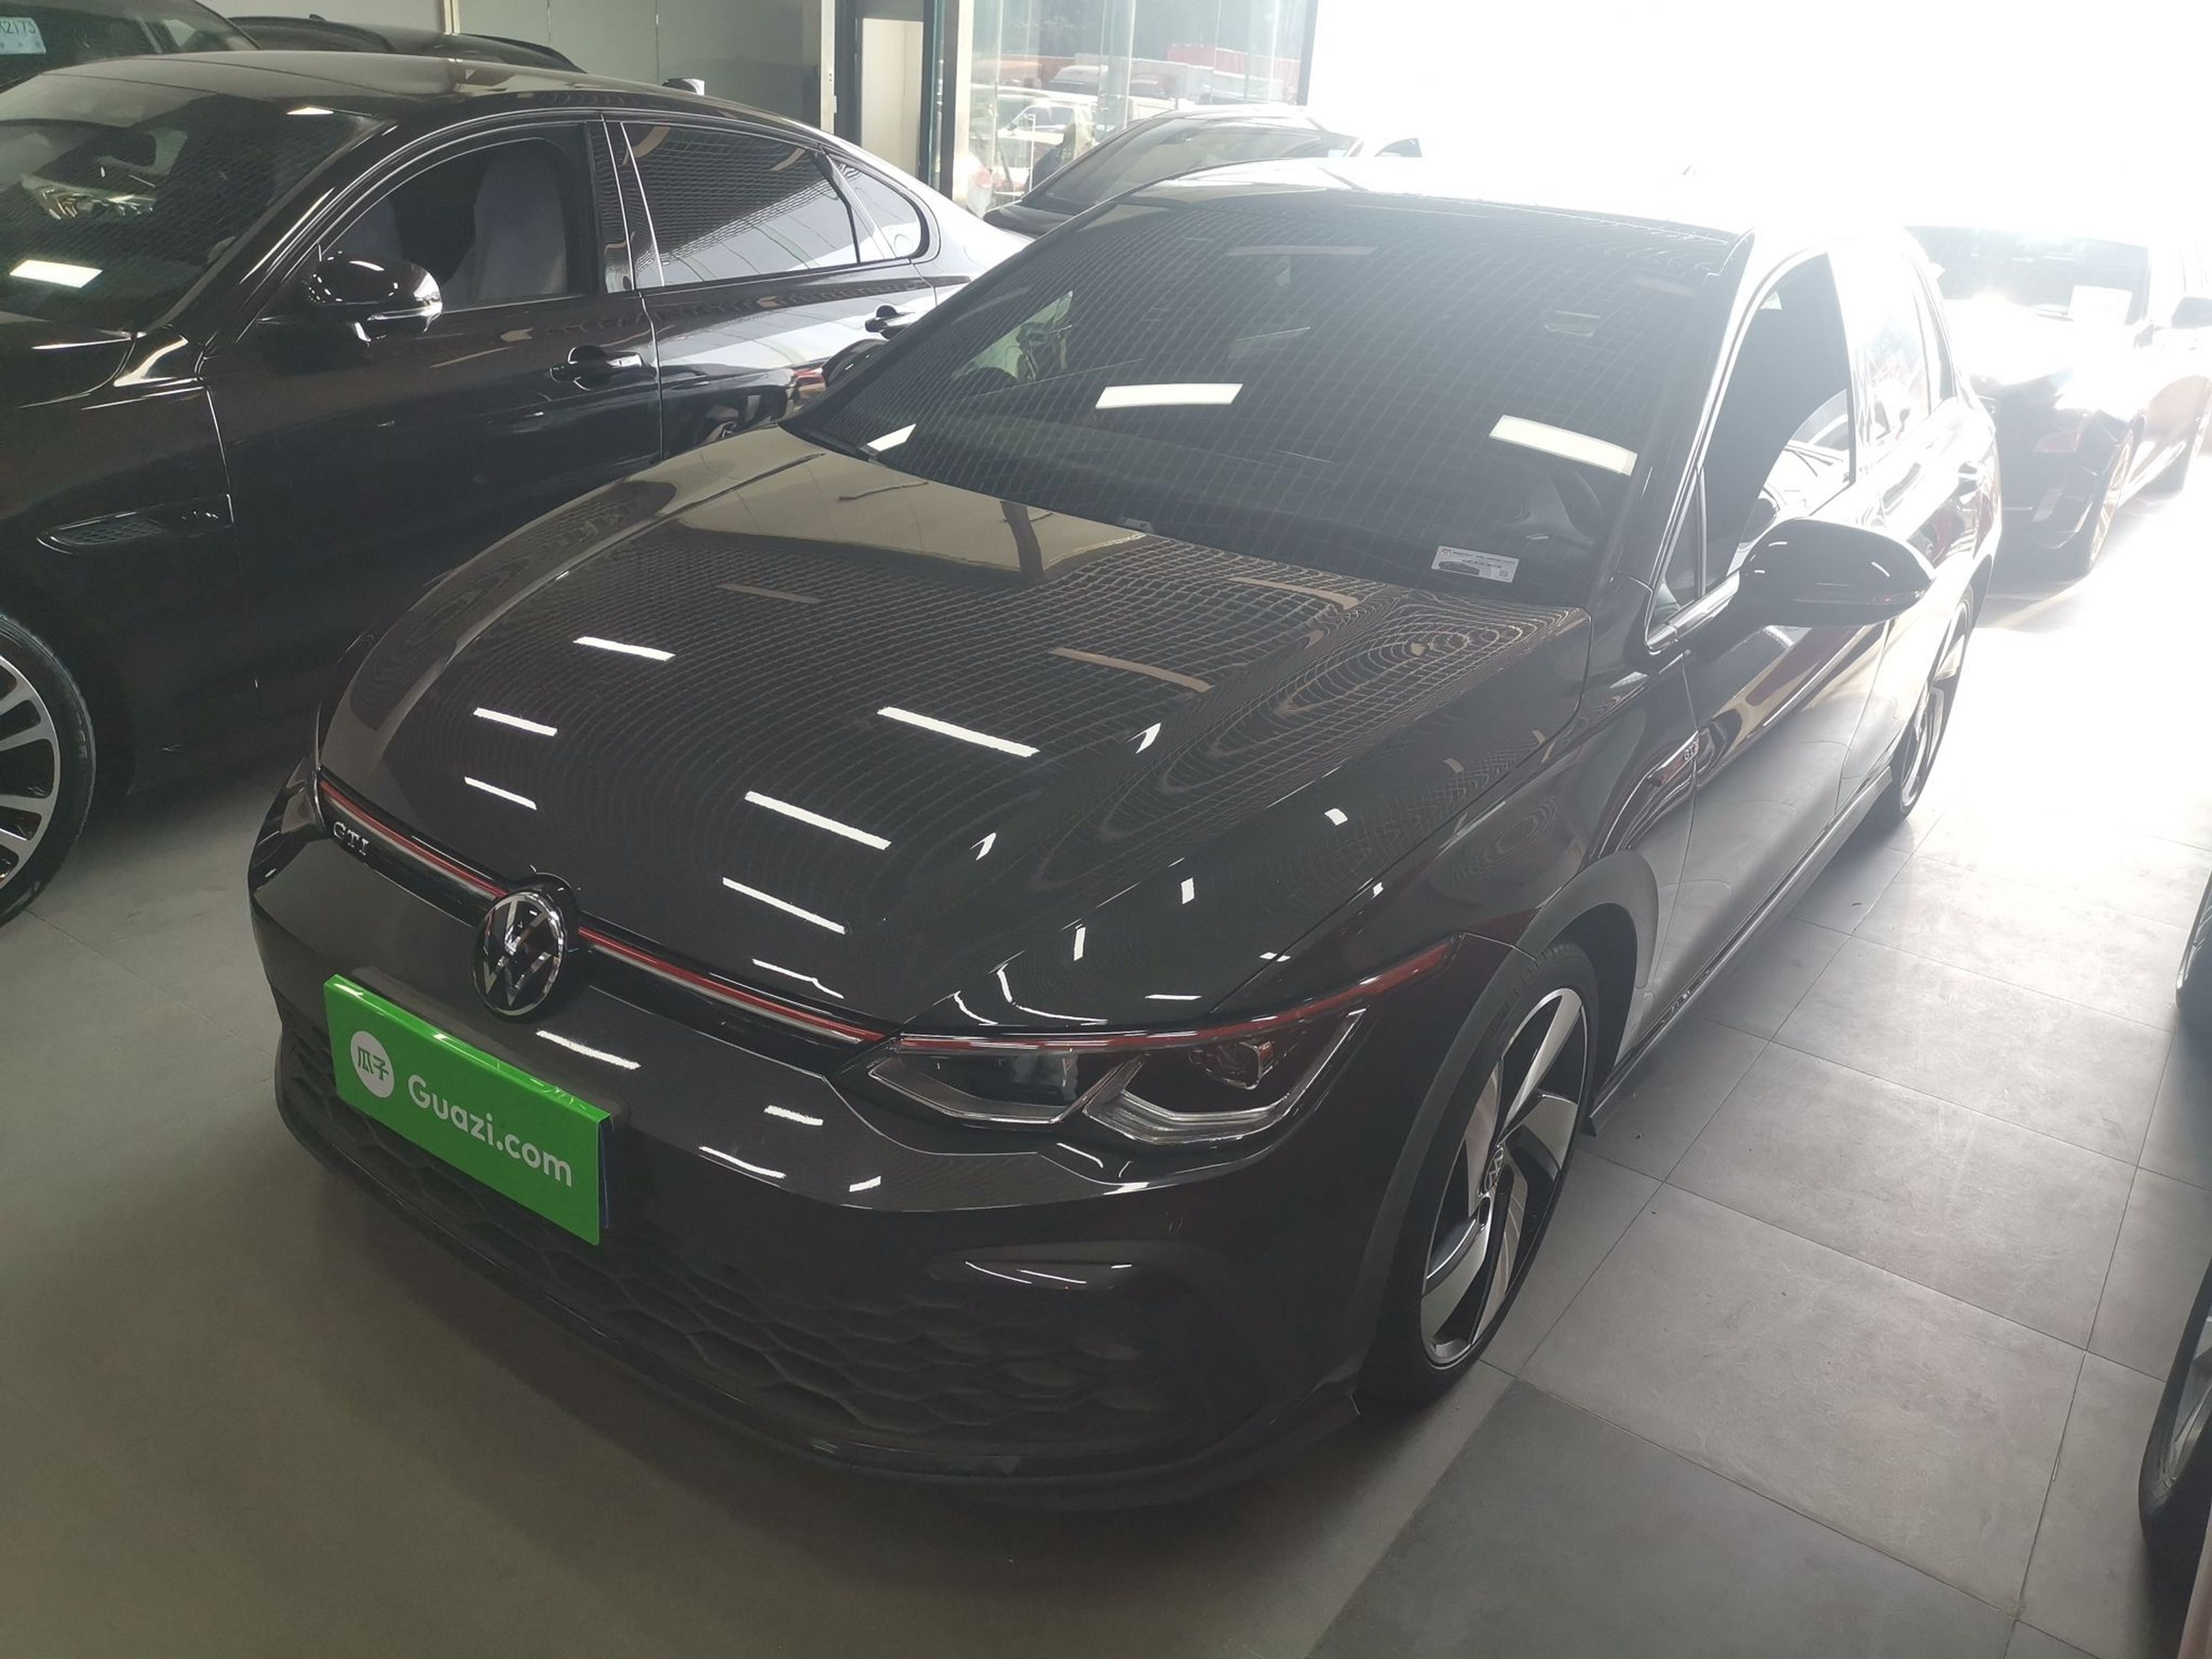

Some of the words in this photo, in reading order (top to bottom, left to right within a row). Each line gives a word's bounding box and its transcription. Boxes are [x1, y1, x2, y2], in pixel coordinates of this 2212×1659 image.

[333, 821, 369, 856] GTI
[357, 1046, 390, 1081] 瓜子
[407, 1074, 572, 1188] Guazi.com
